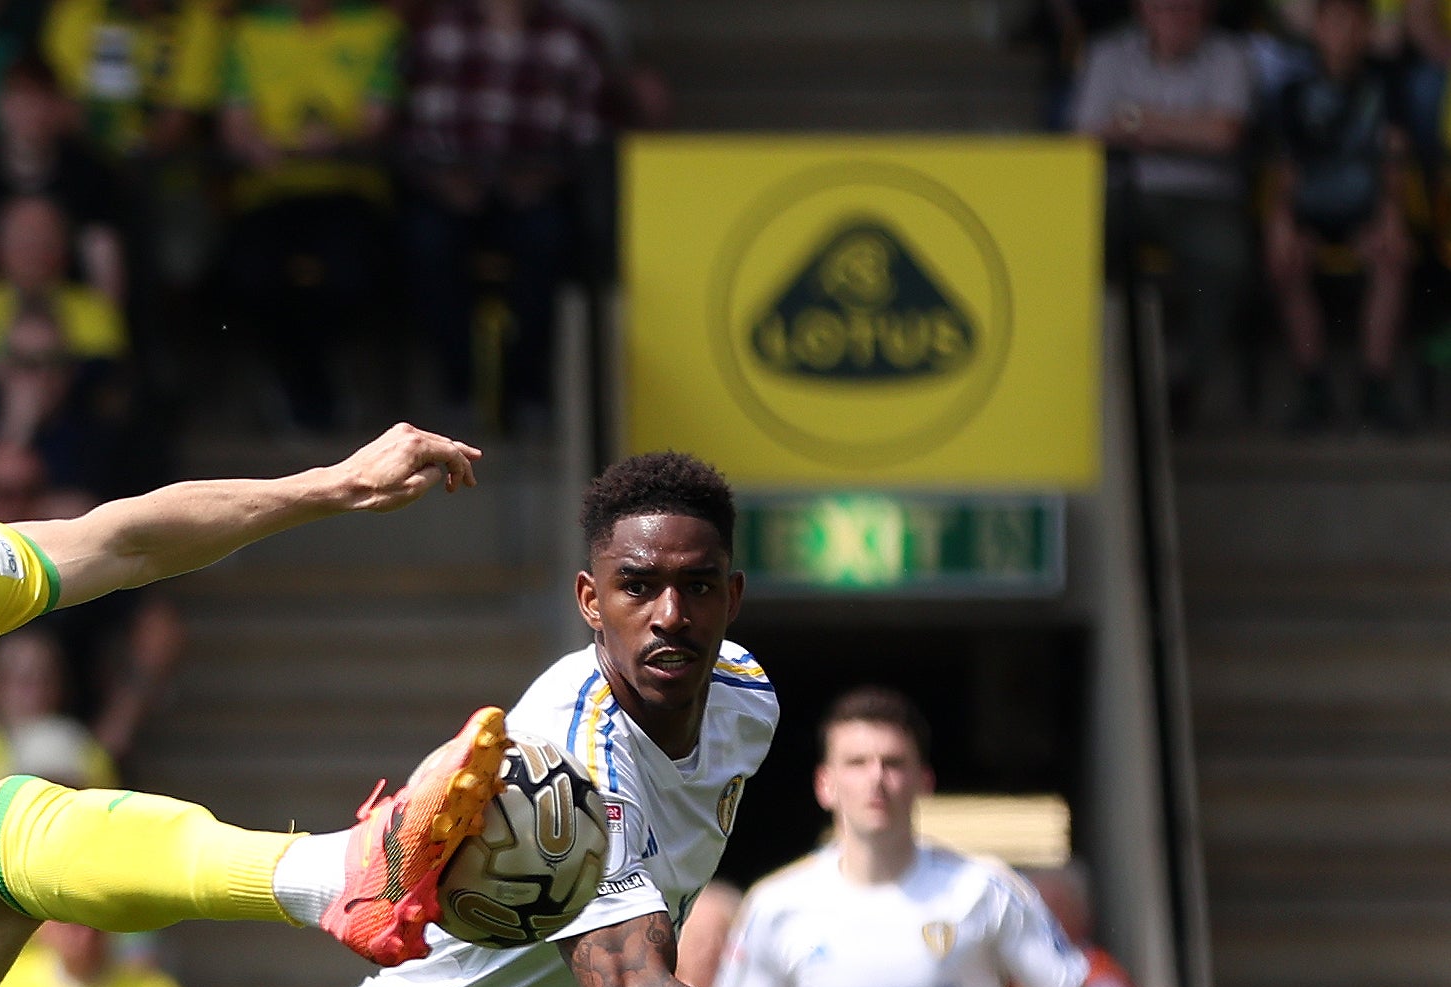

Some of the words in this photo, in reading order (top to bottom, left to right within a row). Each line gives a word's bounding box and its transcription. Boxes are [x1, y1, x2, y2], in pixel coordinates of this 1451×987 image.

[759, 308, 972, 370] LOTUS
[759, 498, 943, 582] EXIT
[606, 806, 621, 819] et
[597, 874, 644, 896] GETHER
